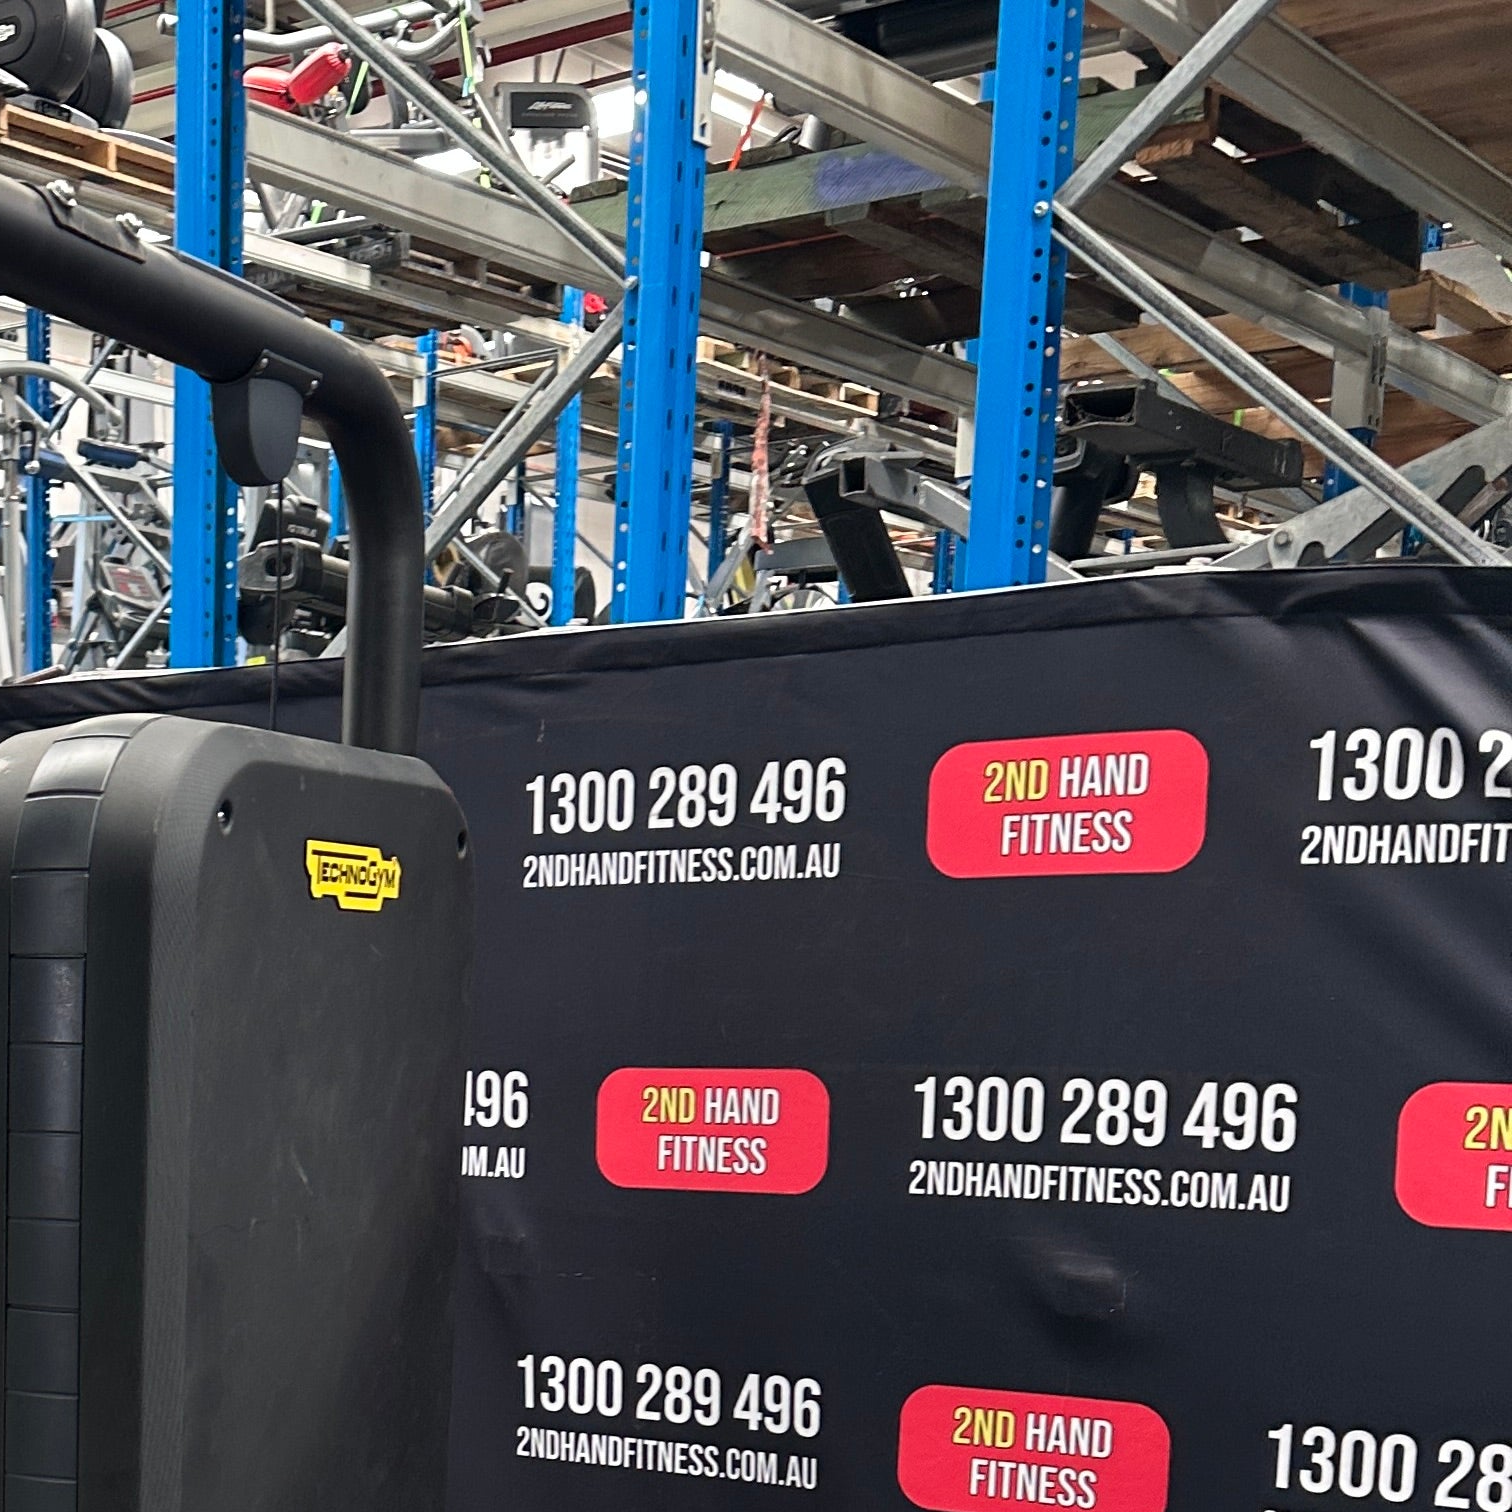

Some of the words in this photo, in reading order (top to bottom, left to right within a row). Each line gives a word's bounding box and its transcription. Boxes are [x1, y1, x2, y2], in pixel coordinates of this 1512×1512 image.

[983, 758, 1049, 803] 2ND
[1059, 752, 1150, 799] HAND
[1309, 727, 1465, 801] 1300
[1478, 729, 1512, 798] 2
[525, 768, 636, 835] 1300
[647, 763, 739, 829] 289
[750, 757, 847, 824] 496
[1000, 809, 1133, 856] FITNESS
[1300, 823, 1512, 865] 2NDHANDFIT
[522, 842, 842, 888] 2NDHANDFITNESS.COM.AU
[640, 1086, 696, 1124] 2ND
[704, 1087, 780, 1125] HAND
[913, 1075, 1046, 1143] 1300
[1059, 1078, 1169, 1148] 289
[1182, 1081, 1298, 1153] 496
[656, 1135, 768, 1175] FITNESS
[908, 1159, 1291, 1214] 2NDHANDFITNESS.COM.AU
[516, 1354, 624, 1418] 1300
[635, 1363, 722, 1427] 289
[733, 1373, 823, 1438] 496
[515, 1425, 819, 1490] 2NDHANDFITNESS.COM.AU
[952, 1406, 1015, 1449] 2ND
[1024, 1412, 1113, 1459] HAND
[969, 1457, 1098, 1510] FITNESS
[1267, 1423, 1418, 1503] 1300
